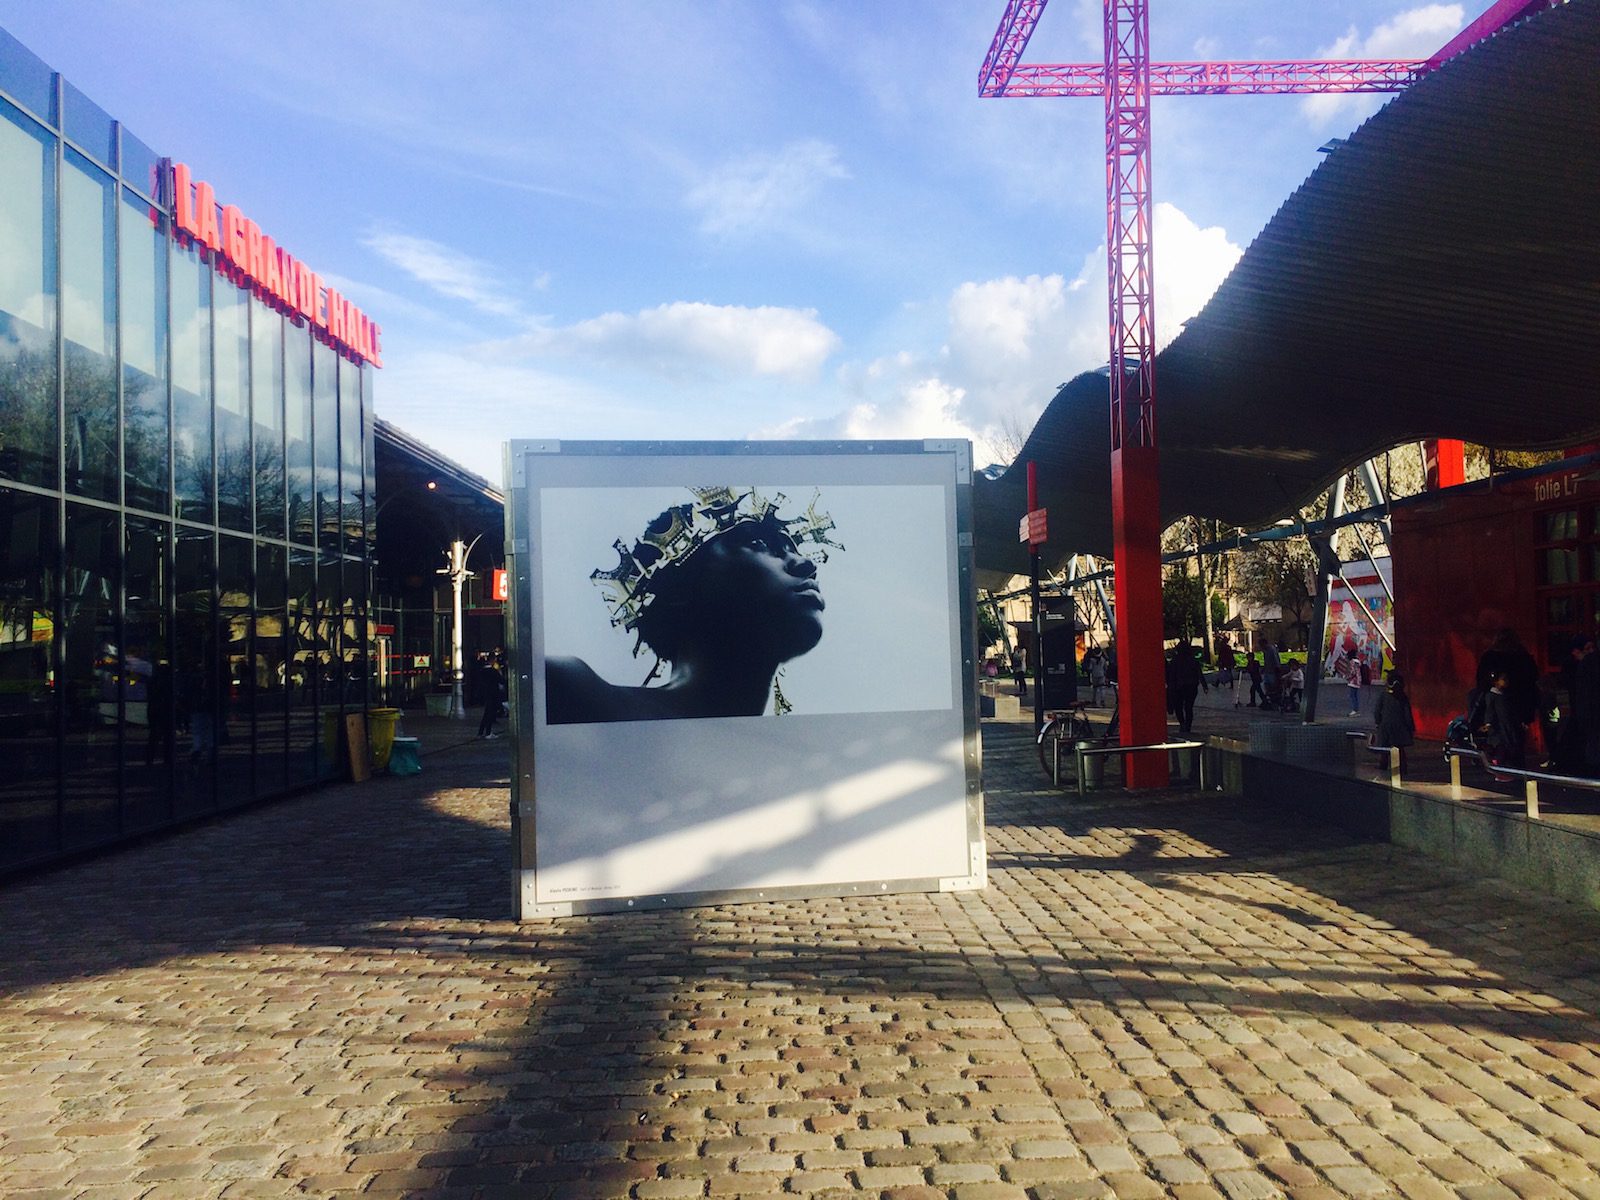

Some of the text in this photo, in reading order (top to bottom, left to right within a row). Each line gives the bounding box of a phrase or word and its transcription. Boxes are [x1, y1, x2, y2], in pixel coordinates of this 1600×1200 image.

[175, 163, 383, 369] LA GRANDE HALLE
[1534, 473, 1580, 502] folie L7
